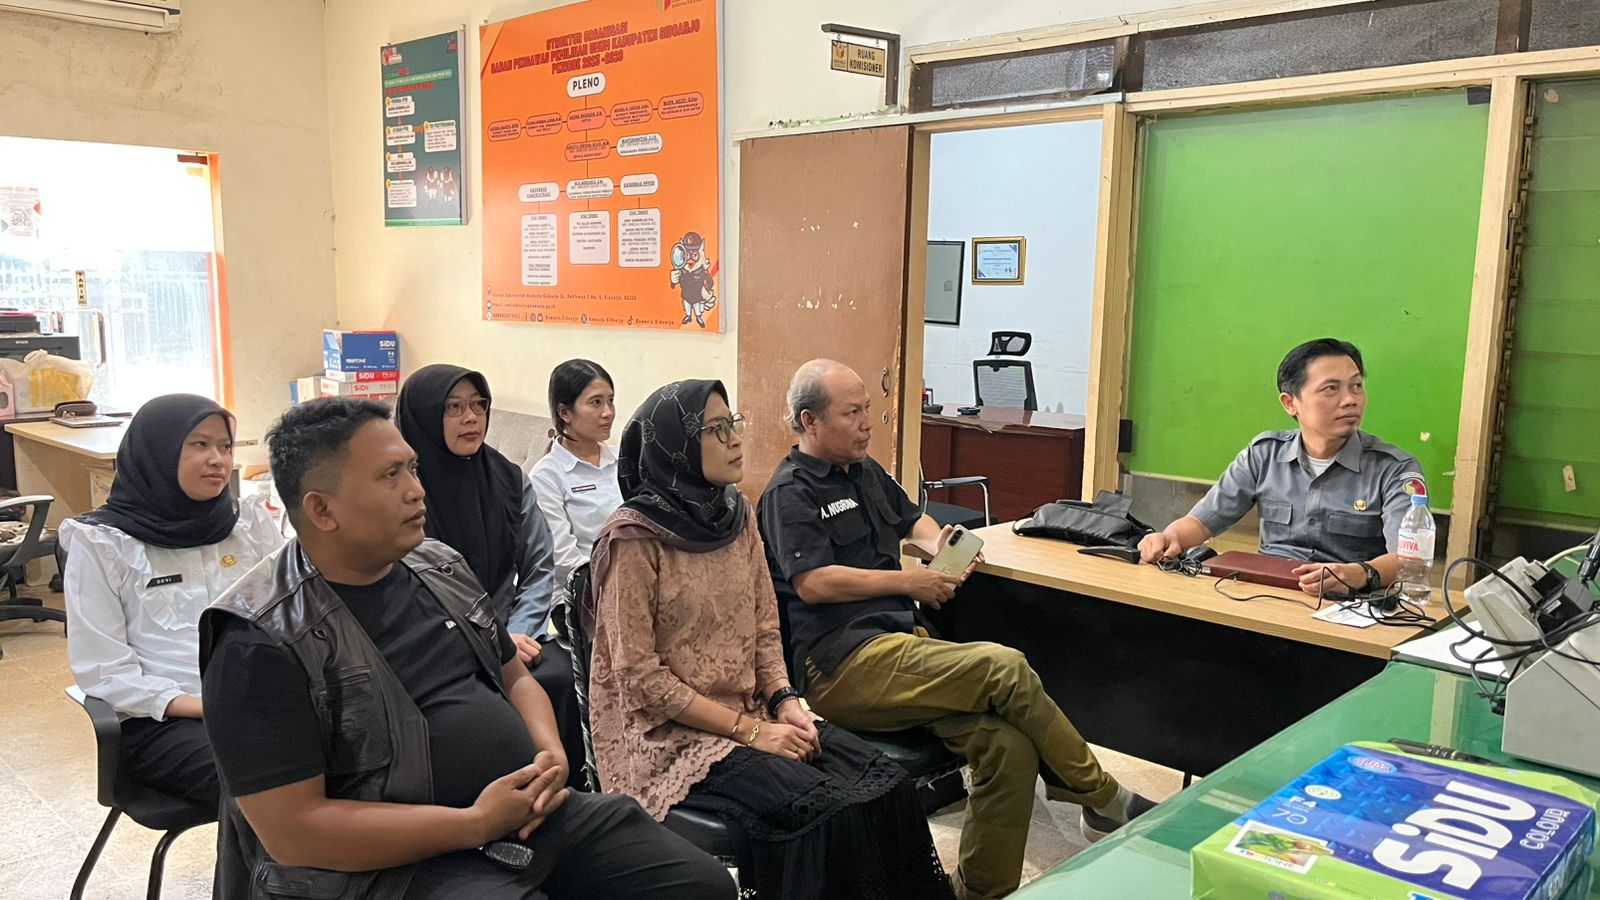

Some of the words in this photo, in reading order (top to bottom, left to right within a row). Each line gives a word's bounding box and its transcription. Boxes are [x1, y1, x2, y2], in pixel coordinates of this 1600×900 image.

[546, 32, 582, 51] STRUKTUR
[583, 21, 628, 43] ORGANISASI
[513, 52, 550, 70] PENGAWAS
[551, 43, 589, 63] PEMILIHAN
[589, 38, 611, 55] UMUM
[611, 28, 658, 50] KABUPATEN
[659, 18, 700, 40] SIDOARJO
[857, 49, 876, 60] RUANG
[551, 58, 581, 75] PERIODE
[849, 59, 883, 73] KOMISIONER
[572, 77, 600, 91] PLENO
[820, 506, 829, 520] A.
[1289, 796, 1319, 808] F4
[1272, 808, 1307, 825] 70
[1519, 808, 1571, 850] COLOUR
